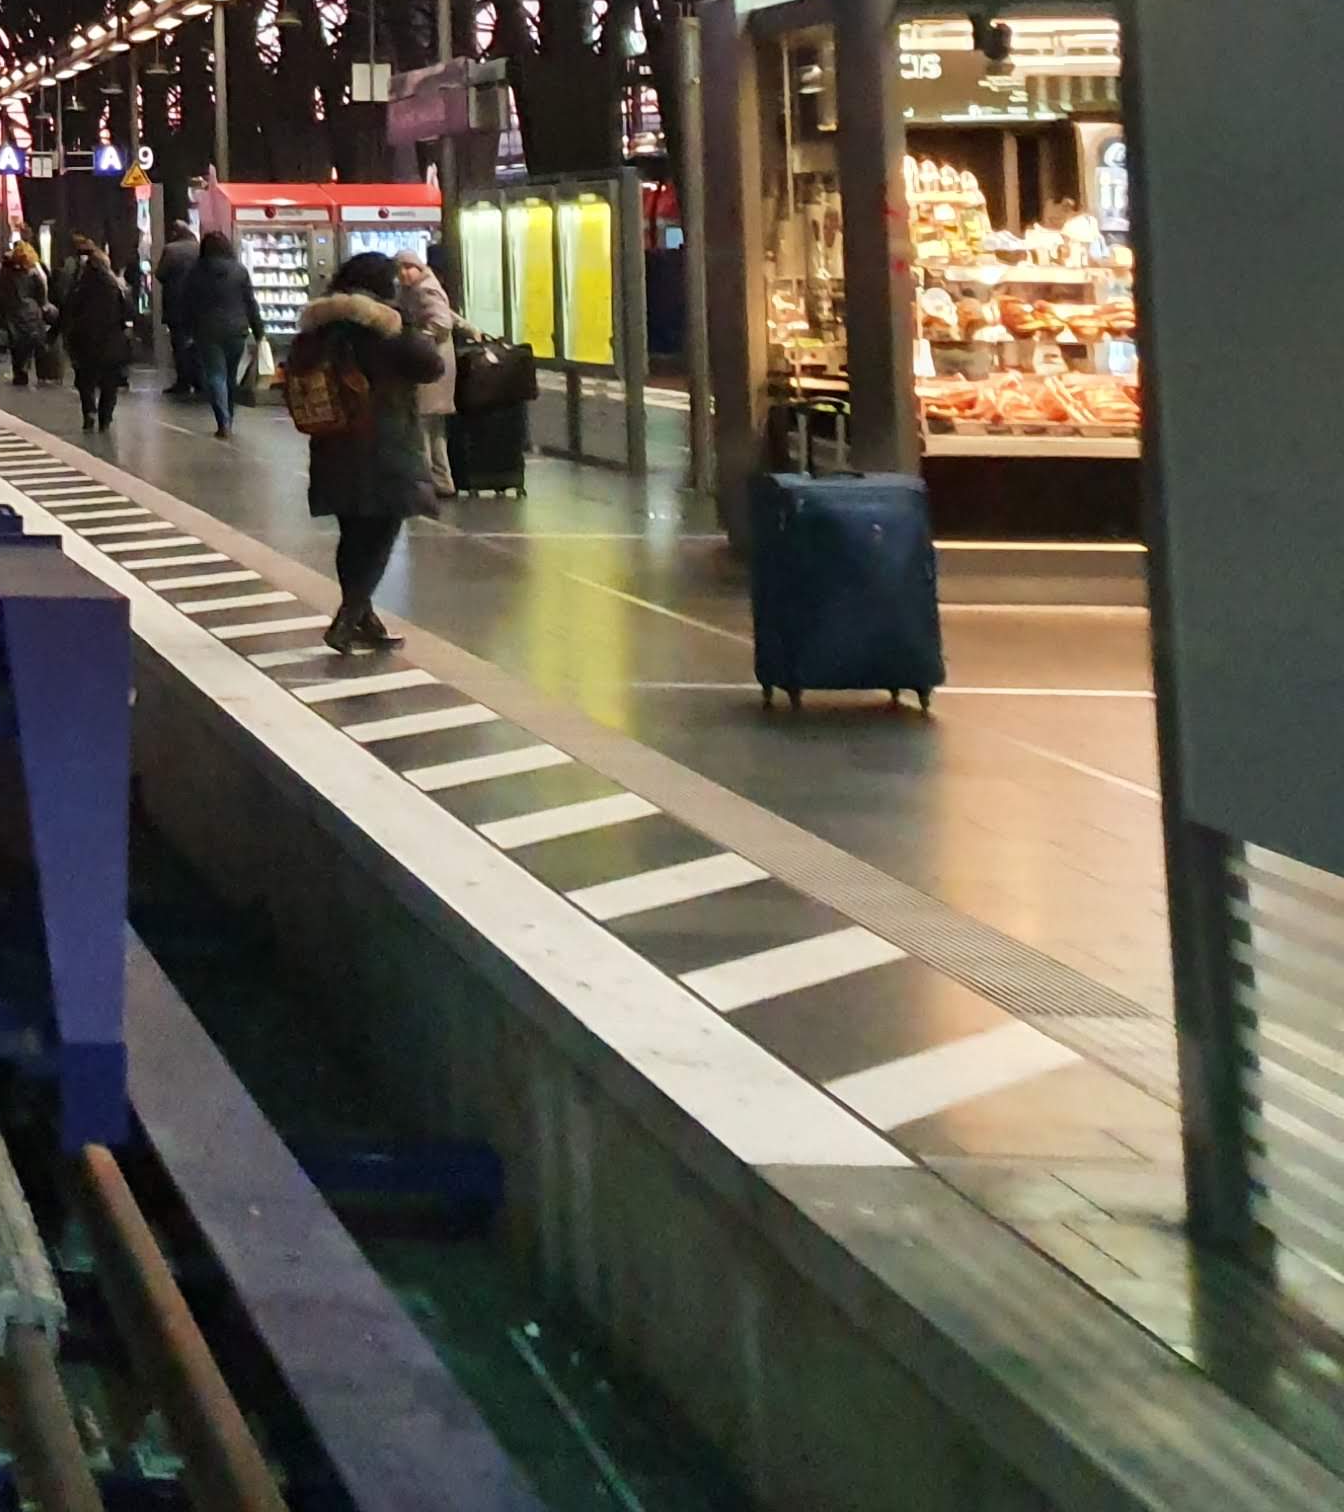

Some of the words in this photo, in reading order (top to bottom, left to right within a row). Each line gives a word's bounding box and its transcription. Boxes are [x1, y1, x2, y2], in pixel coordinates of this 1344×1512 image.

[0, 146, 19, 170] A
[101, 146, 121, 170] A
[139, 146, 154, 170] 9
